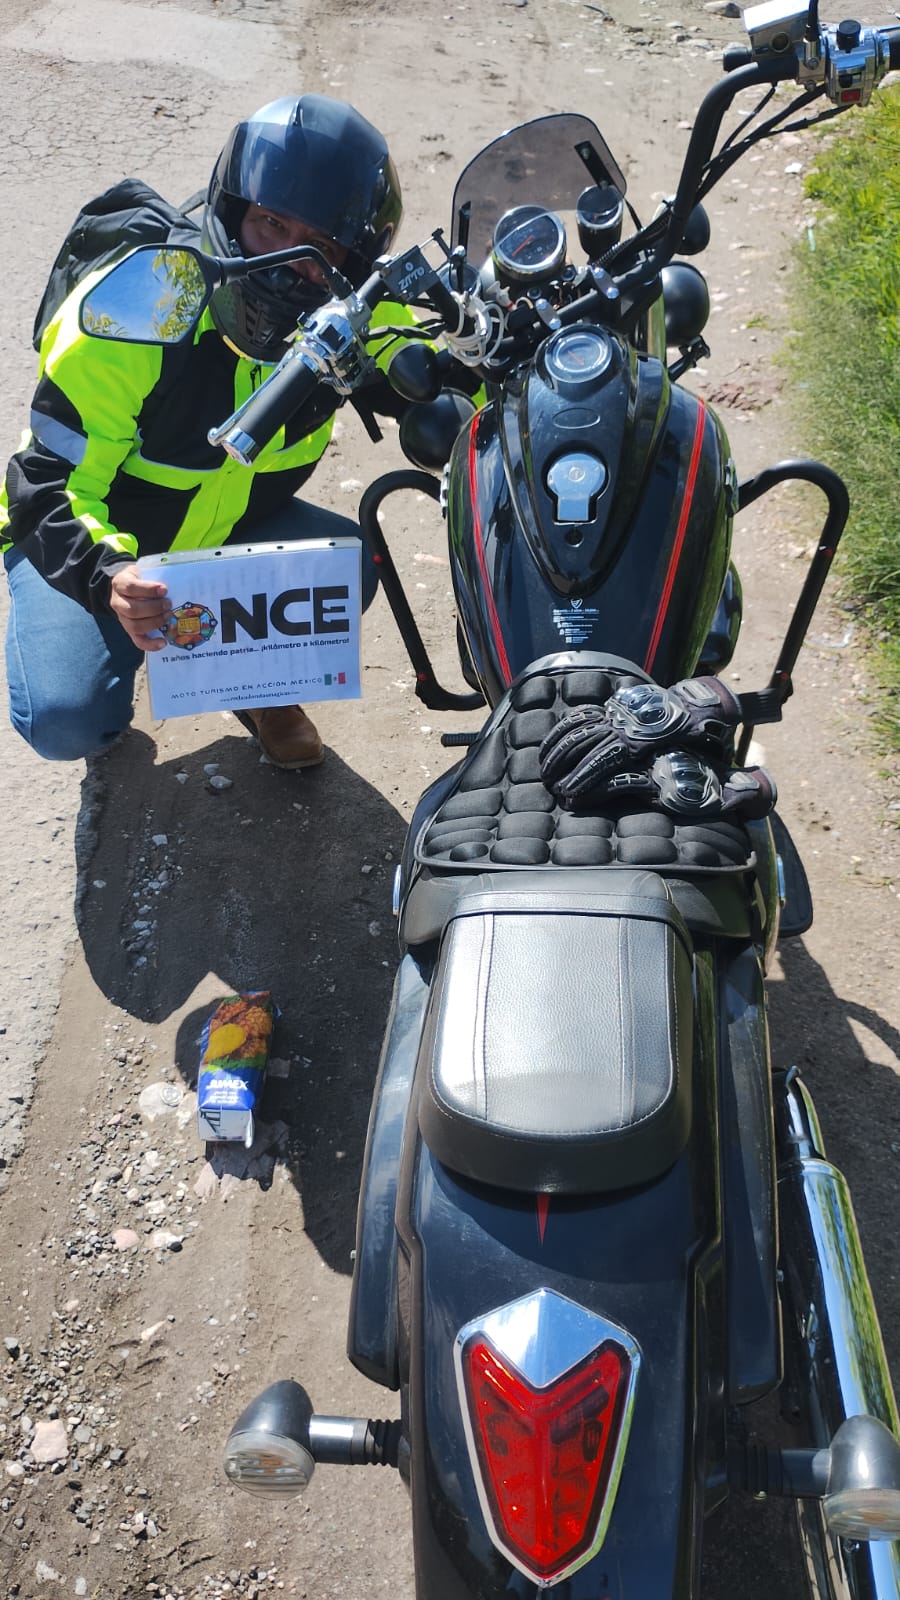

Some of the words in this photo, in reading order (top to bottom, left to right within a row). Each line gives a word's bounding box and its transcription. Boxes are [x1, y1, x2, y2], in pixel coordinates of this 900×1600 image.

[192, 649, 228, 659] haciendo
[171, 691, 196, 699] MOTO
[200, 686, 239, 695] TURISMO
[205, 1079, 249, 1091] JUMEX
